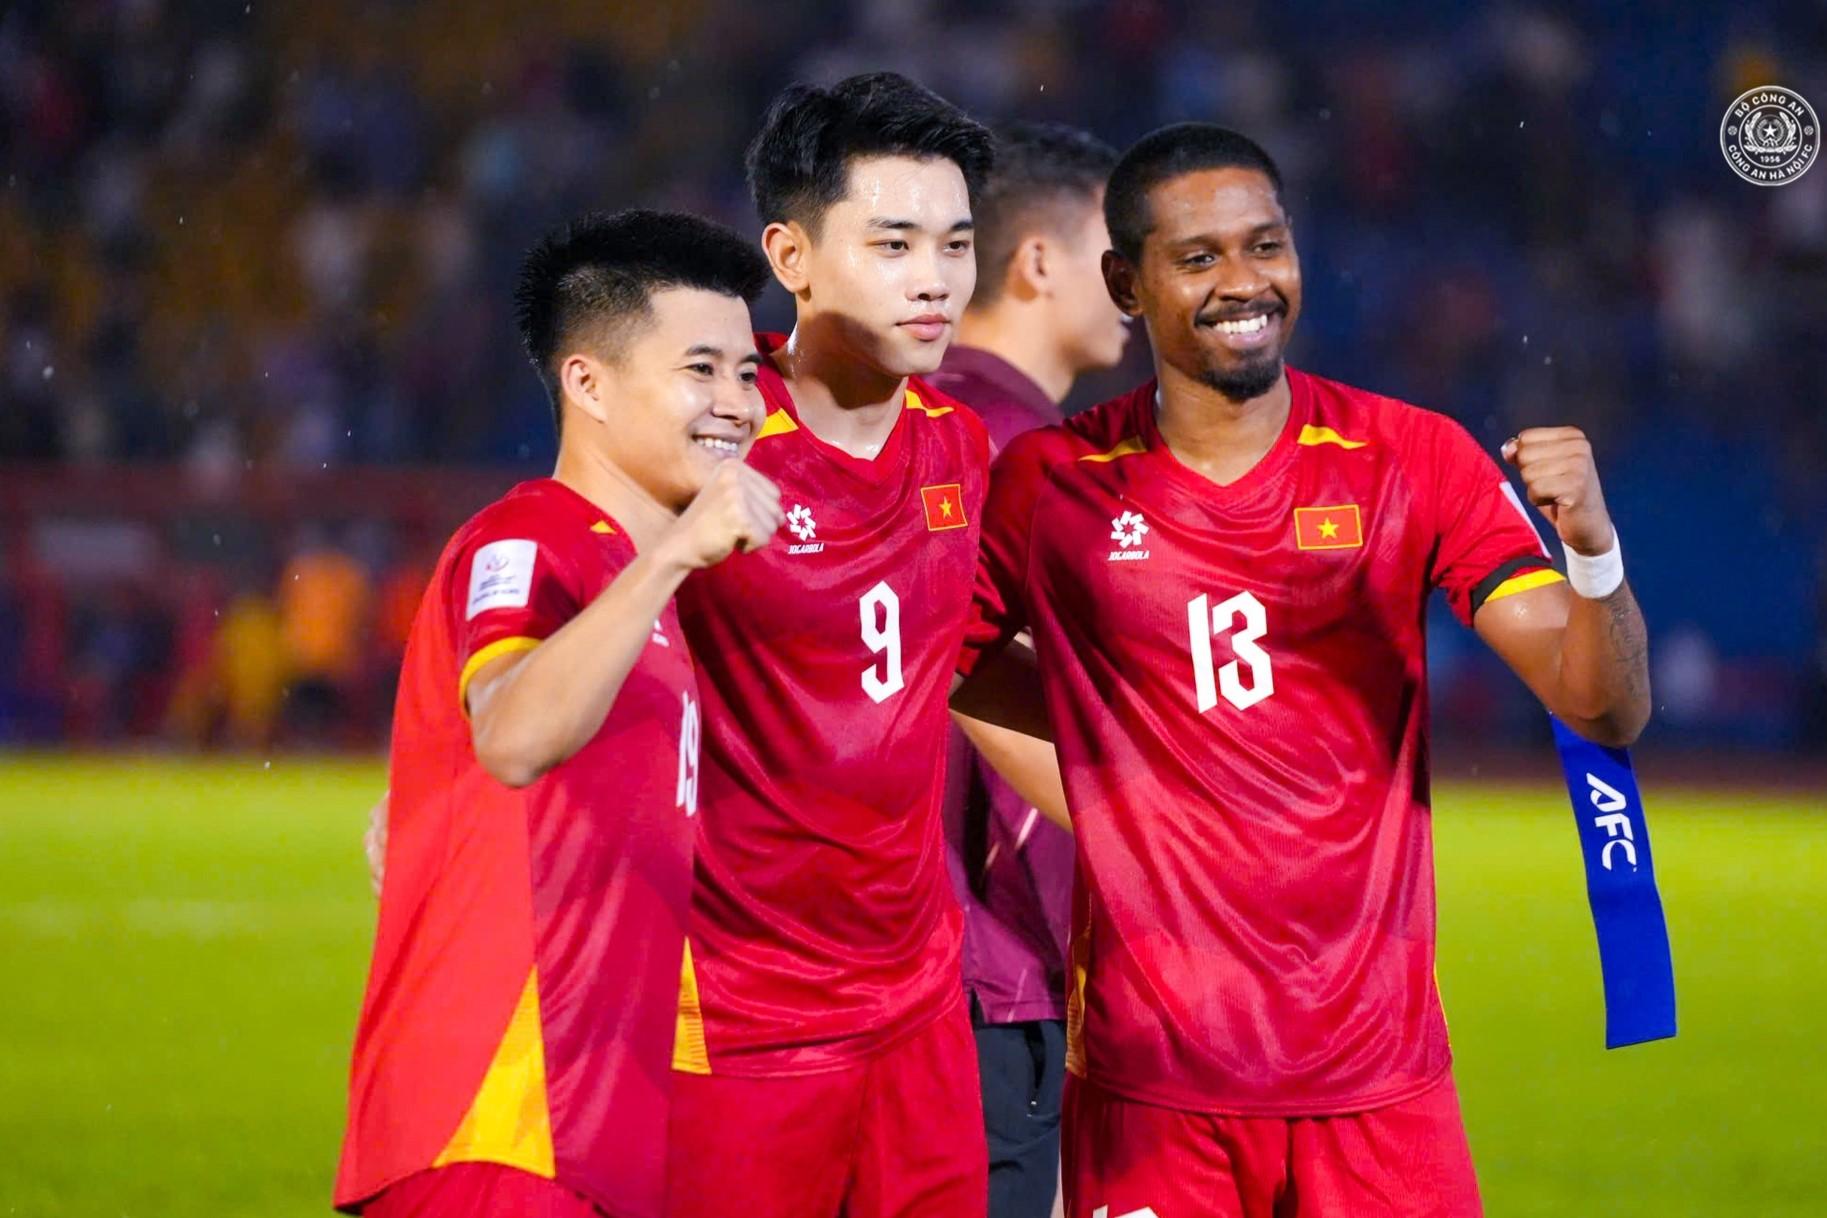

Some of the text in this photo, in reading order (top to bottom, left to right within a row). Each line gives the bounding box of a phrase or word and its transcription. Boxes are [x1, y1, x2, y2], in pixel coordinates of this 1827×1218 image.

[859, 580, 905, 704] 9
[1187, 590, 1275, 714] 13
[676, 690, 699, 817] 19
[1586, 772, 1637, 871] AFC
